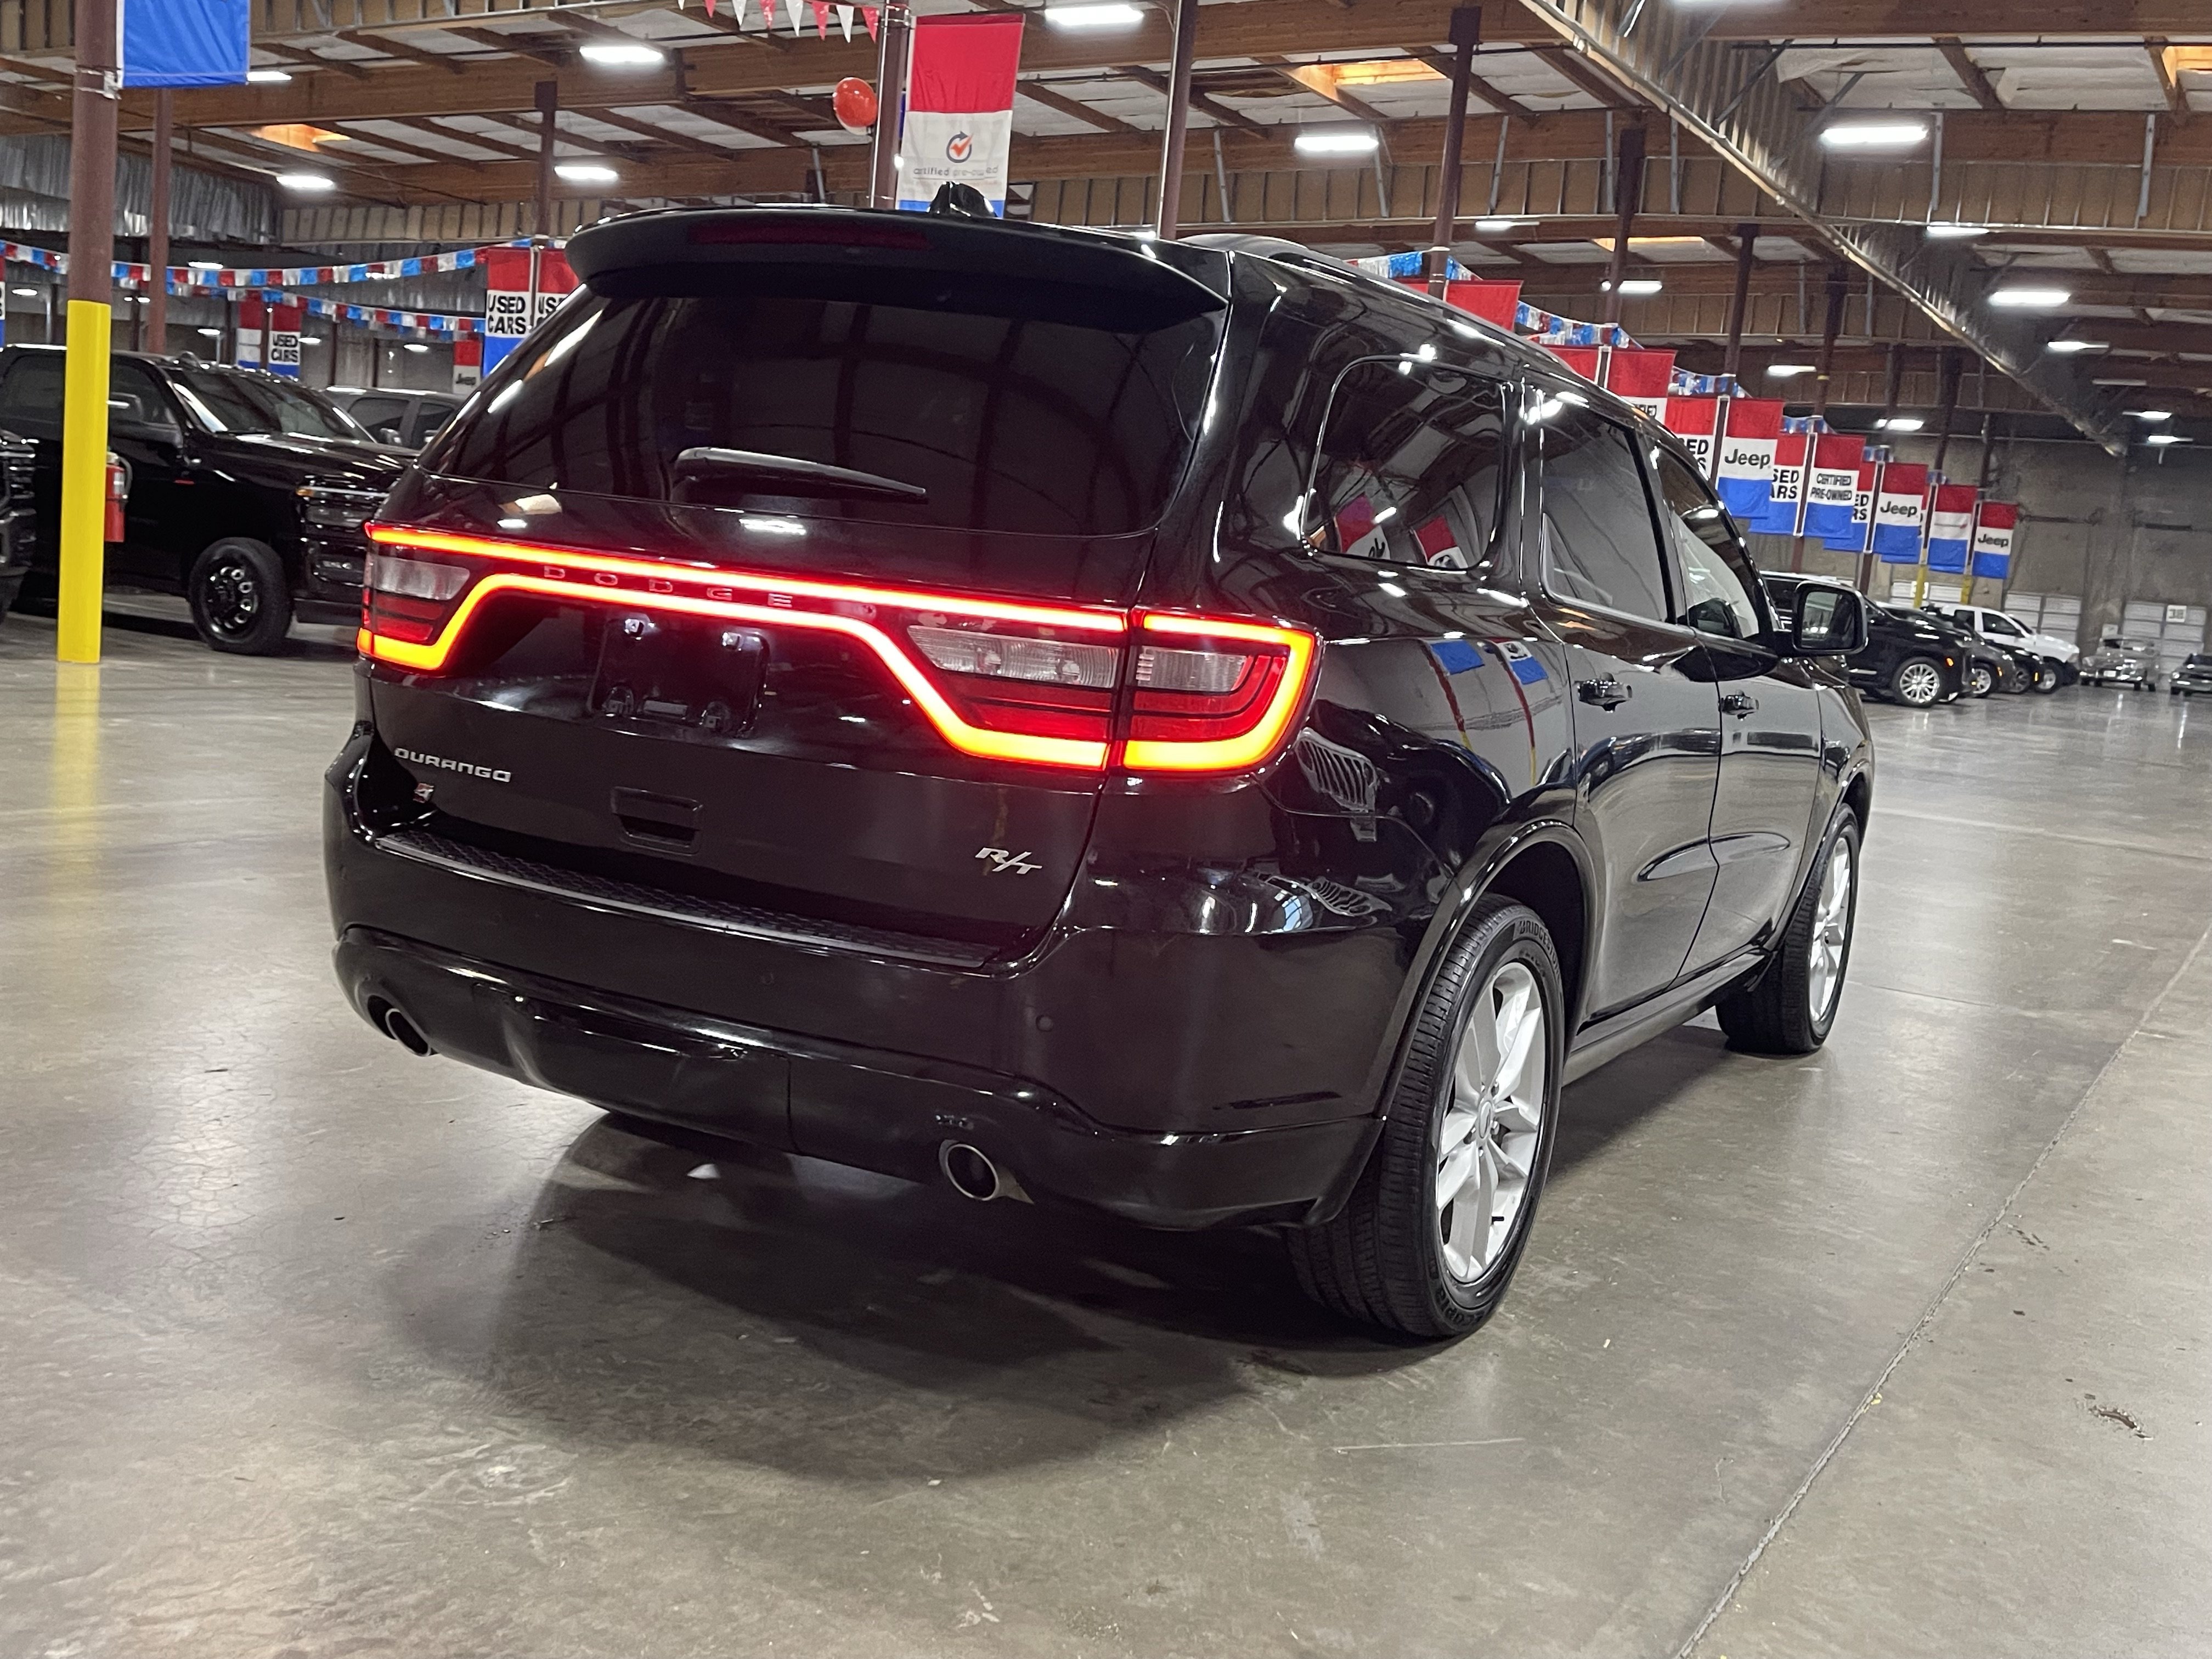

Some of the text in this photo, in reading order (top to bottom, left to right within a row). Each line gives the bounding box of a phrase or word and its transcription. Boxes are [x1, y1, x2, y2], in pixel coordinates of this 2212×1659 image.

[488, 294, 526, 314] USED
[488, 314, 527, 334] CARS
[1724, 448, 1771, 470] Jeep
[1773, 469, 1799, 484] SED
[1880, 501, 1918, 518] Jeep
[1977, 533, 2009, 548] Jeep
[544, 565, 793, 608] DODGE
[394, 747, 512, 783] DURANGO
[974, 847, 1043, 874] R/T
